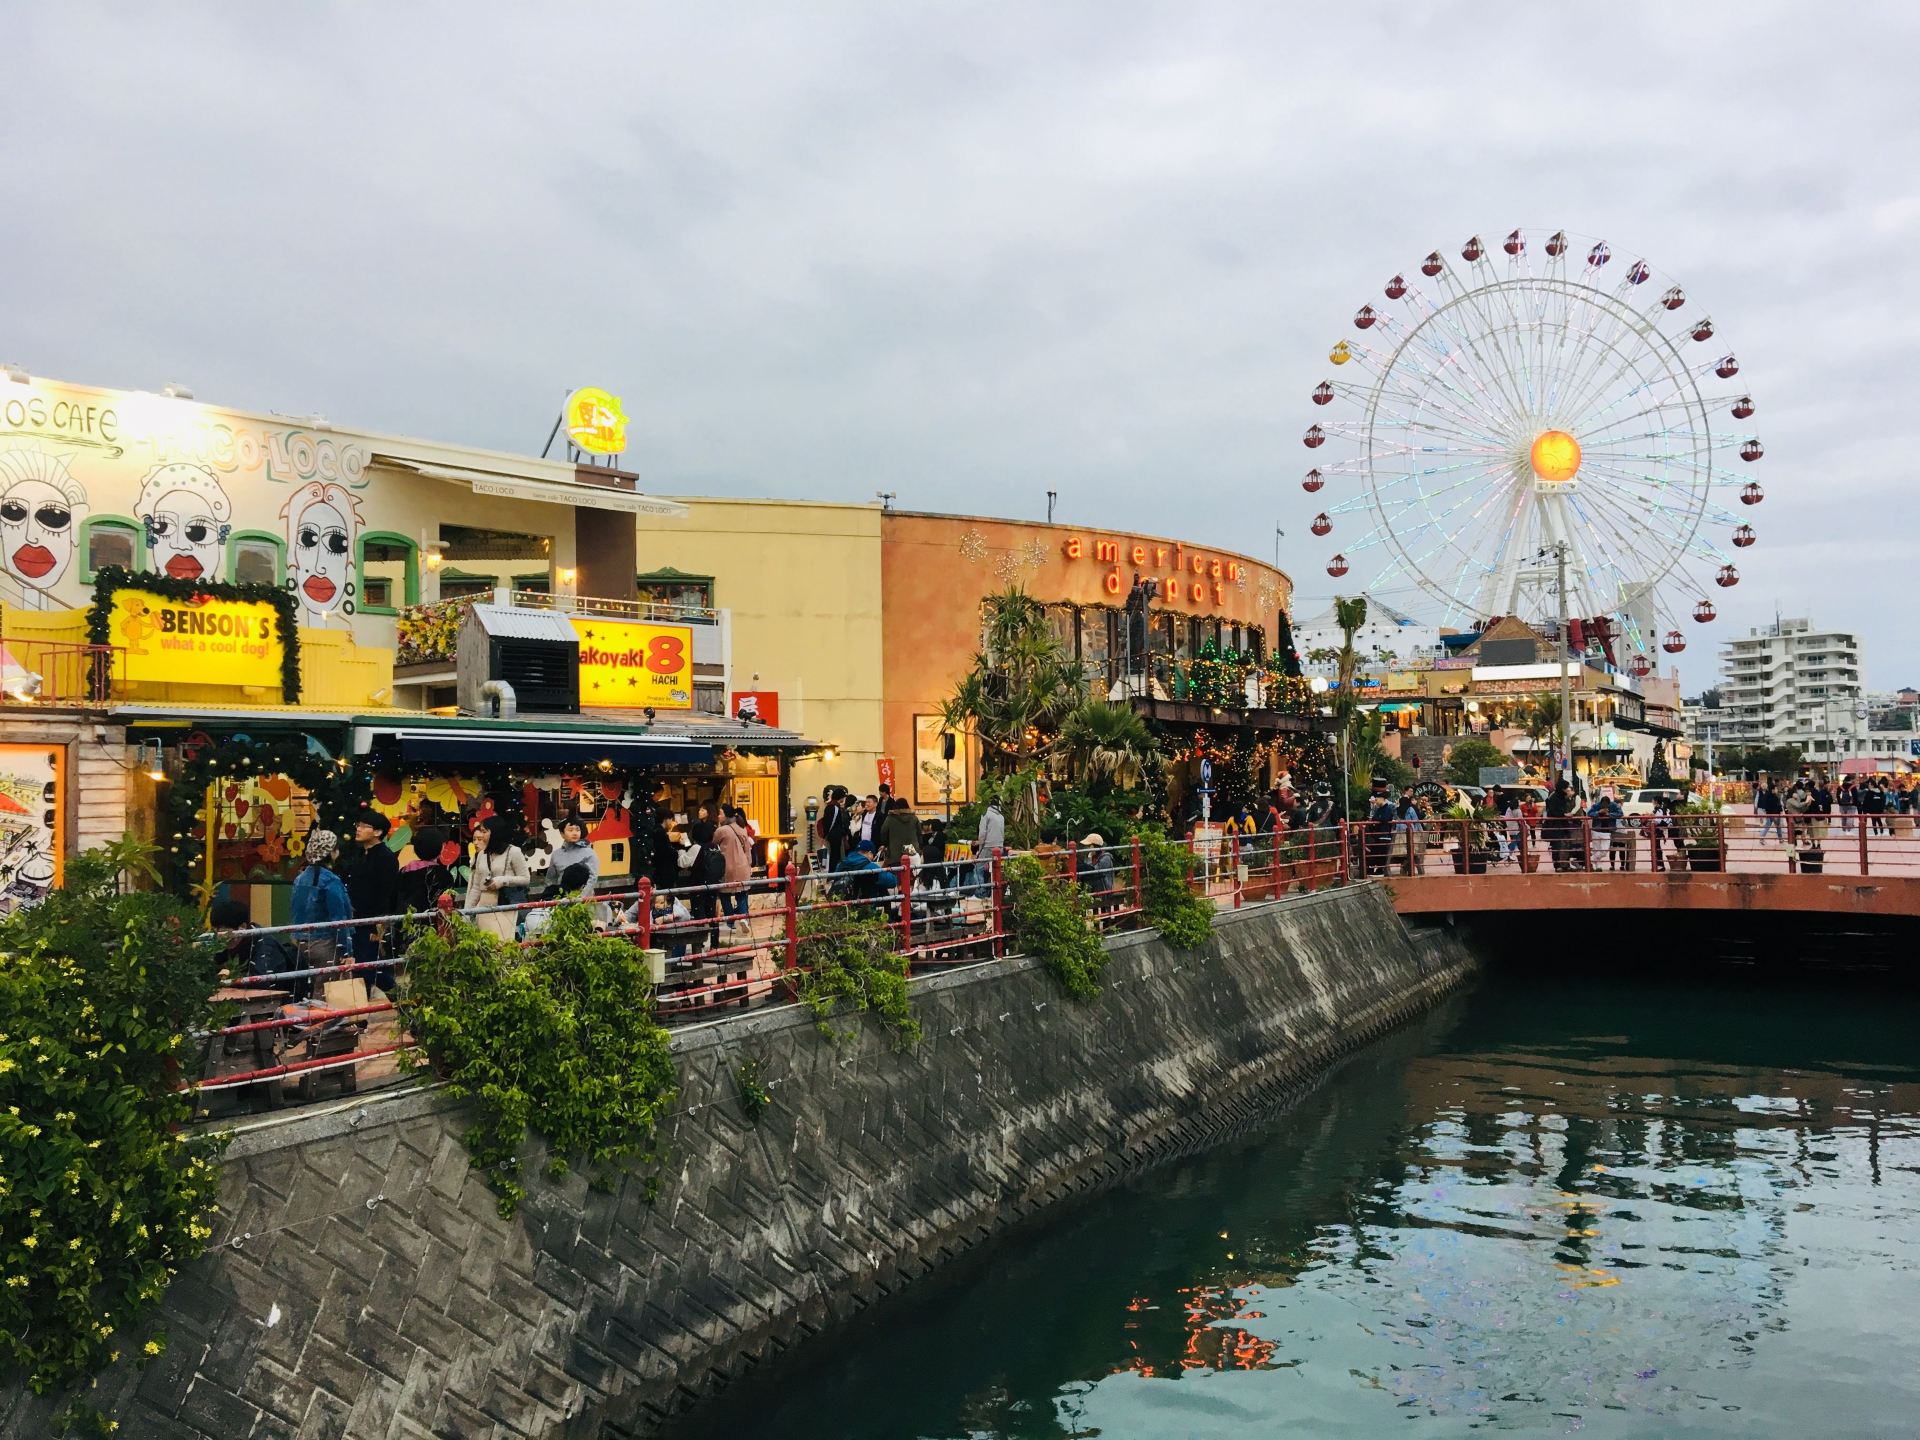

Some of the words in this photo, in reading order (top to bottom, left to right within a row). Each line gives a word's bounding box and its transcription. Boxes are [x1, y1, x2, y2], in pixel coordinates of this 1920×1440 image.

[0, 397, 48, 428] OS
[474, 483, 494, 494] TACO
[495, 486, 515, 496] LOCO
[559, 494, 578, 504] TACO
[578, 496, 597, 506] LOCO
[637, 503, 654, 513] TACO
[655, 505, 671, 515] LOCO
[1065, 536, 1239, 581] american
[1106, 565, 1225, 606] dpot
[160, 635, 195, 651] what
[198, 640, 206, 652] a
[210, 640, 237, 653] cool
[241, 641, 270, 660] dog!
[578, 644, 644, 669] akoyaki
[645, 634, 686, 675] 8
[651, 674, 678, 686] HACHI
